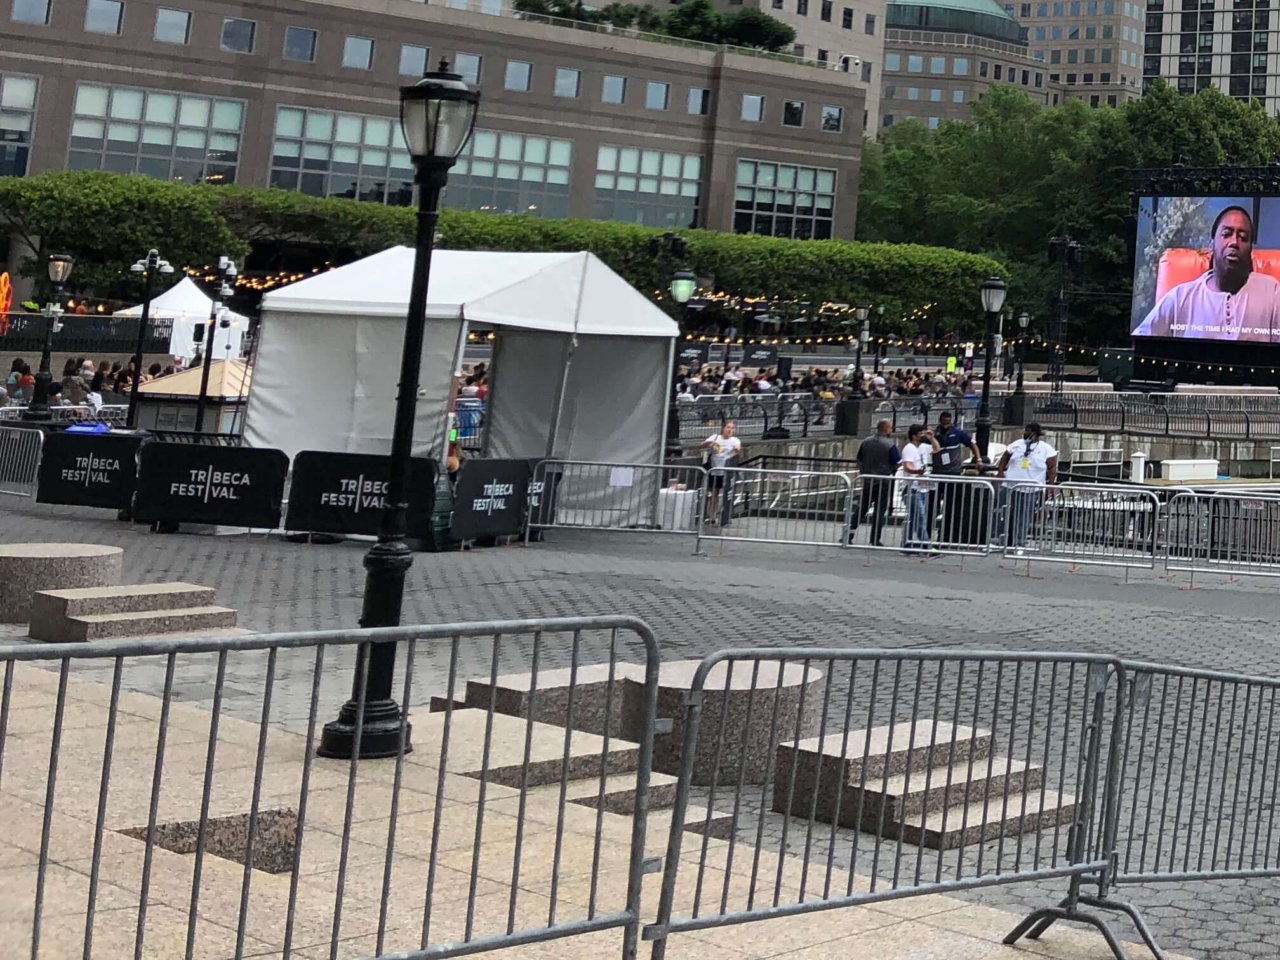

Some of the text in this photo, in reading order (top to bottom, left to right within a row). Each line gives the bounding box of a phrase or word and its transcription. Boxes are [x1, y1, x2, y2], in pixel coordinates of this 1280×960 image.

[1170, 323, 1188, 331] MOST
[1253, 327, 1270, 335] OWN
[75, 455, 120, 470] TRIBECA
[61, 469, 110, 484] FESTIVAL
[189, 468, 251, 486] TRIBECA
[170, 482, 238, 500] FESTIVAL
[340, 477, 390, 495] TRIBEC
[483, 482, 514, 496] TRIBECA
[472, 498, 506, 512] FESTIVAL
